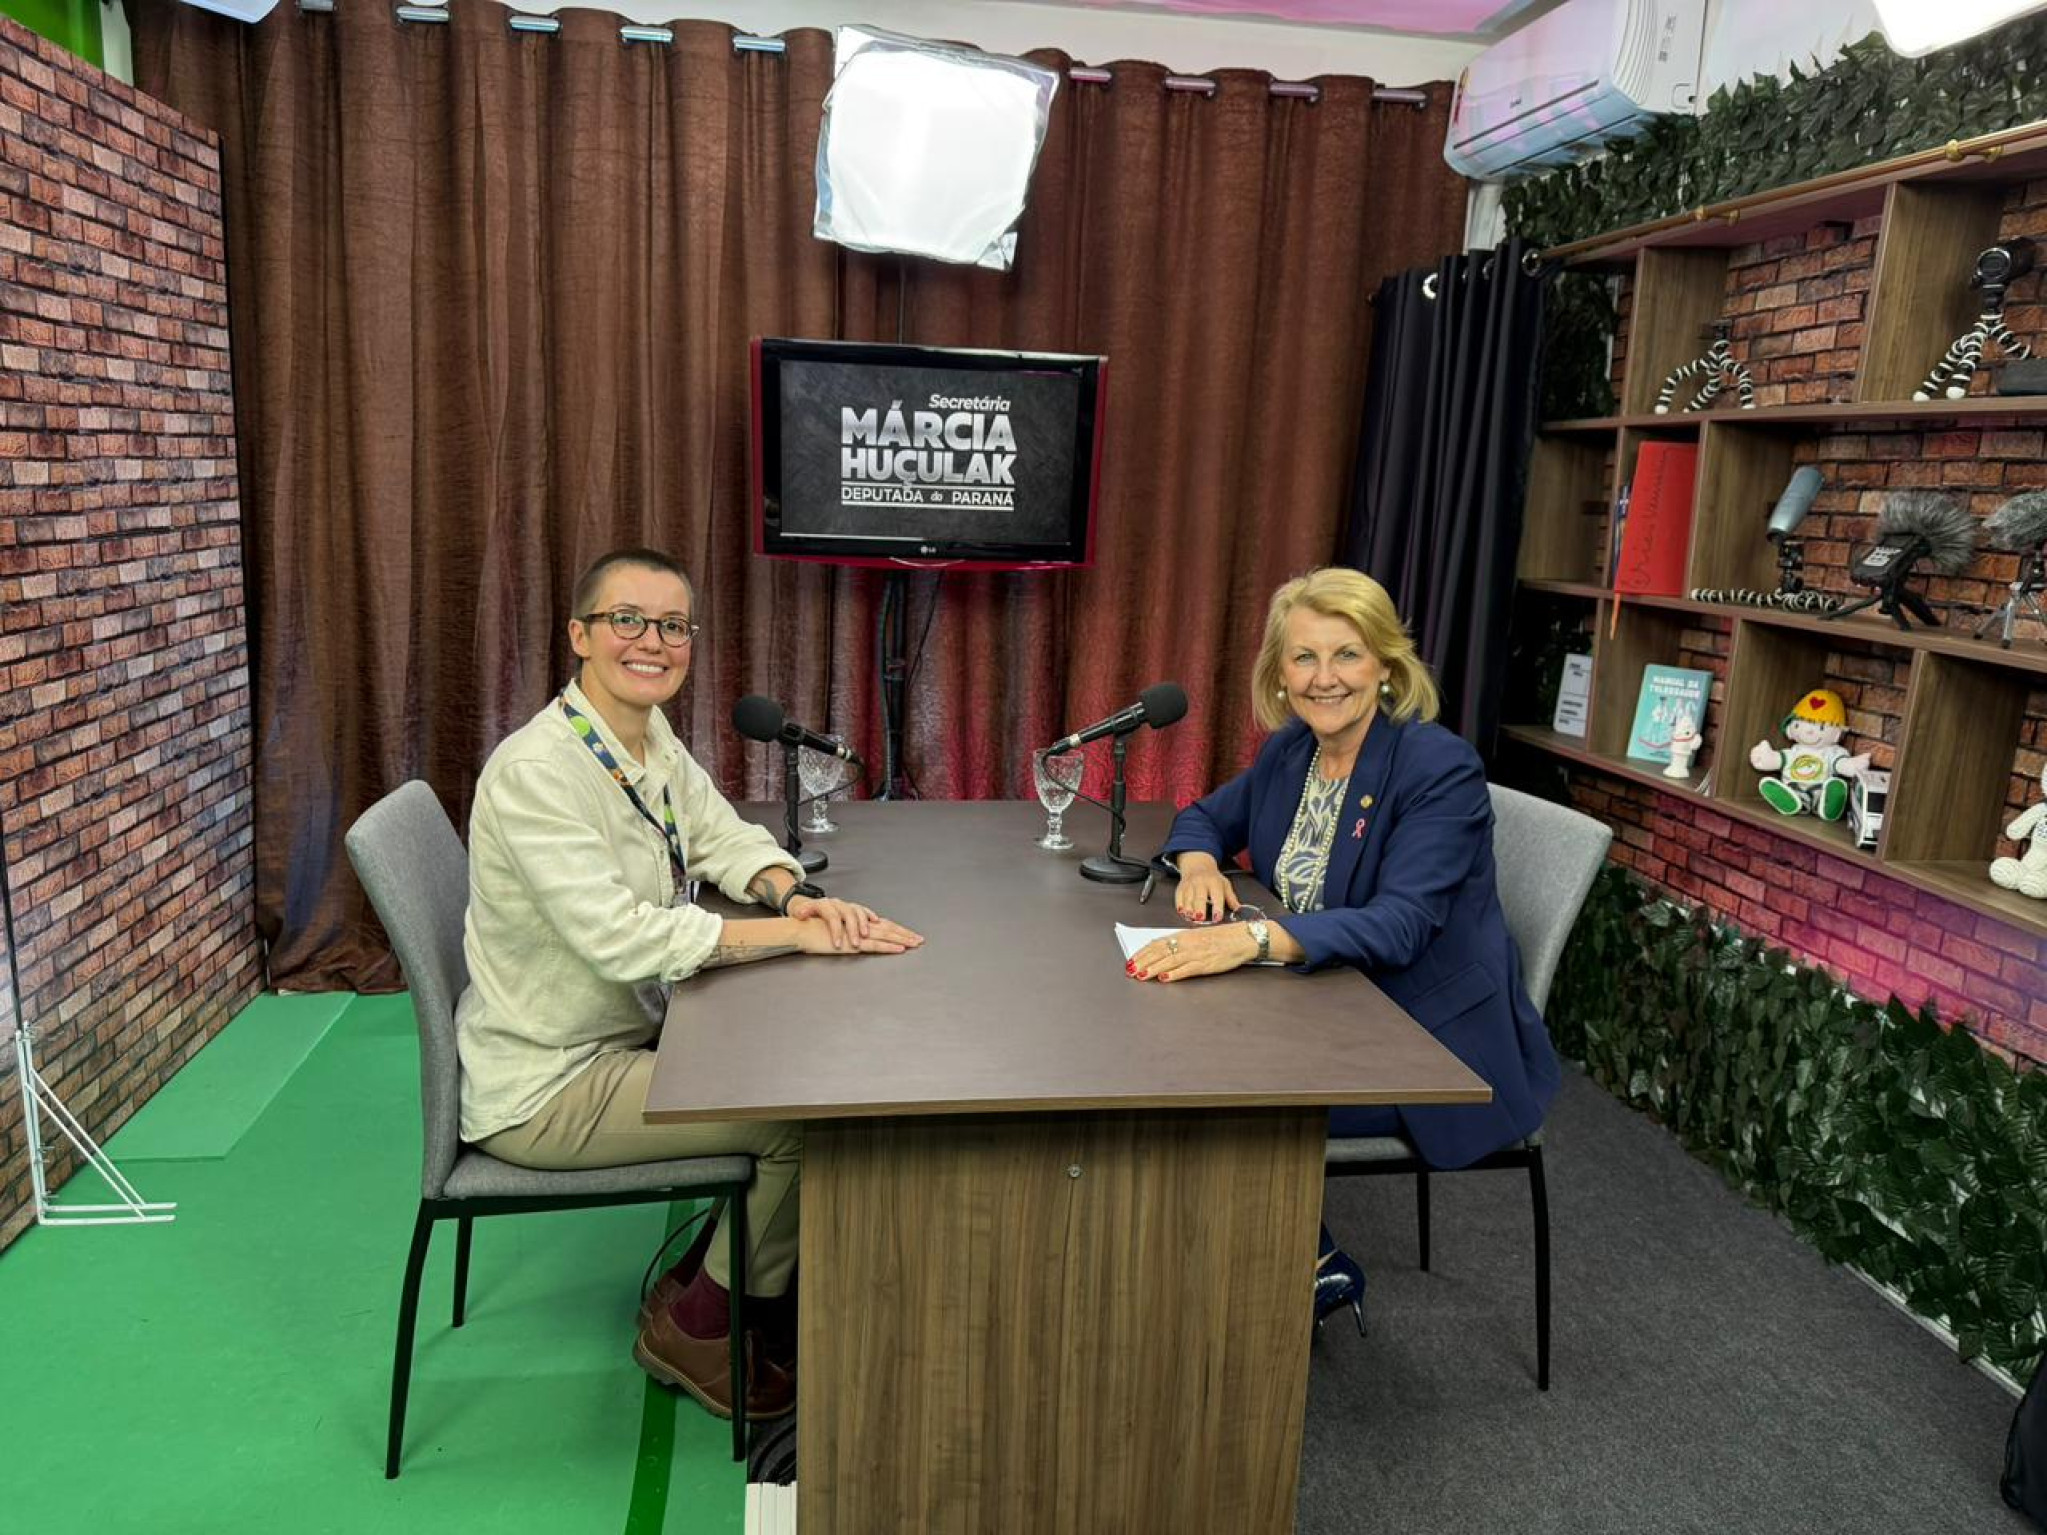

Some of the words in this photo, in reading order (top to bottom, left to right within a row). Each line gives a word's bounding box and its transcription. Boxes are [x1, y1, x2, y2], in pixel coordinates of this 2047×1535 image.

[929, 393, 1011, 412] Secretária
[841, 399, 1017, 452] MÁRCIA
[841, 447, 1017, 491] HUÇULAK
[841, 487, 924, 503] DEPUTADA
[930, 491, 943, 502] do
[952, 490, 1014, 506] PARANÁ
